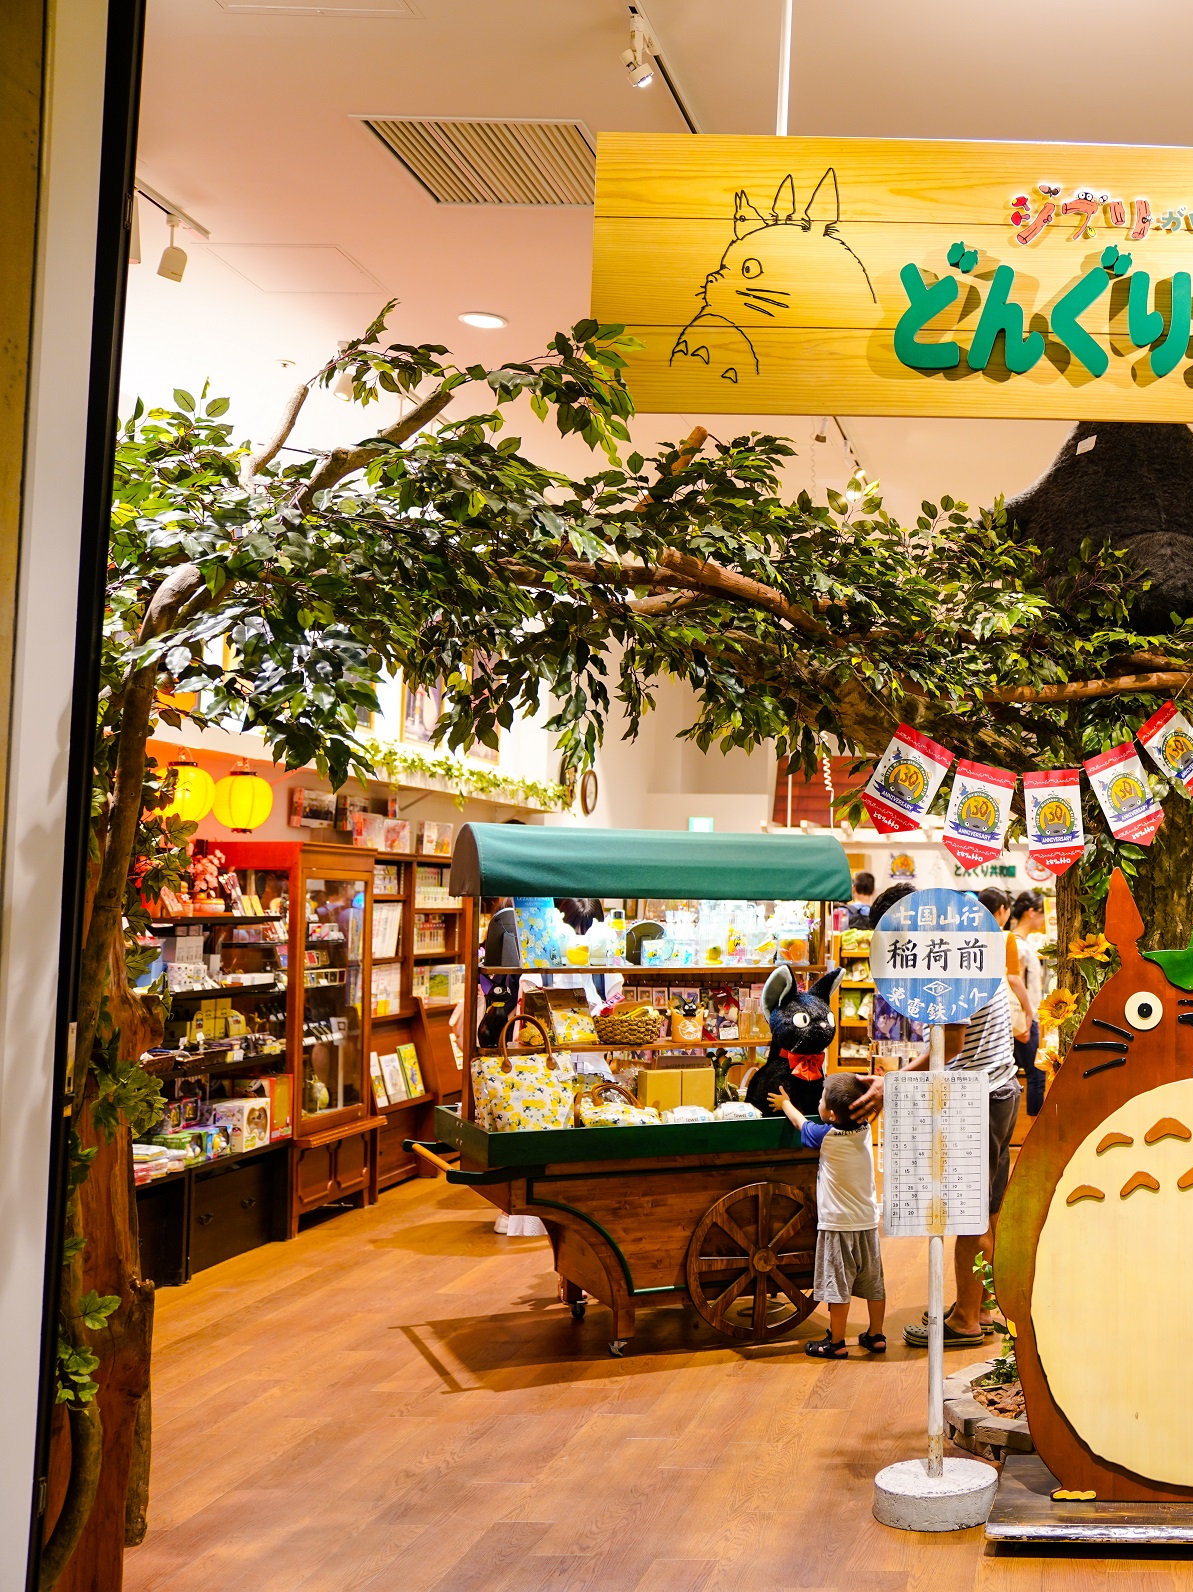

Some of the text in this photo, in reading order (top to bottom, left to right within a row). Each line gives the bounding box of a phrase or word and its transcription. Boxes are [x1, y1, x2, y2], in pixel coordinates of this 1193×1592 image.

[892, 905, 983, 926] 七国山行
[887, 938, 988, 972] 稲荷前
